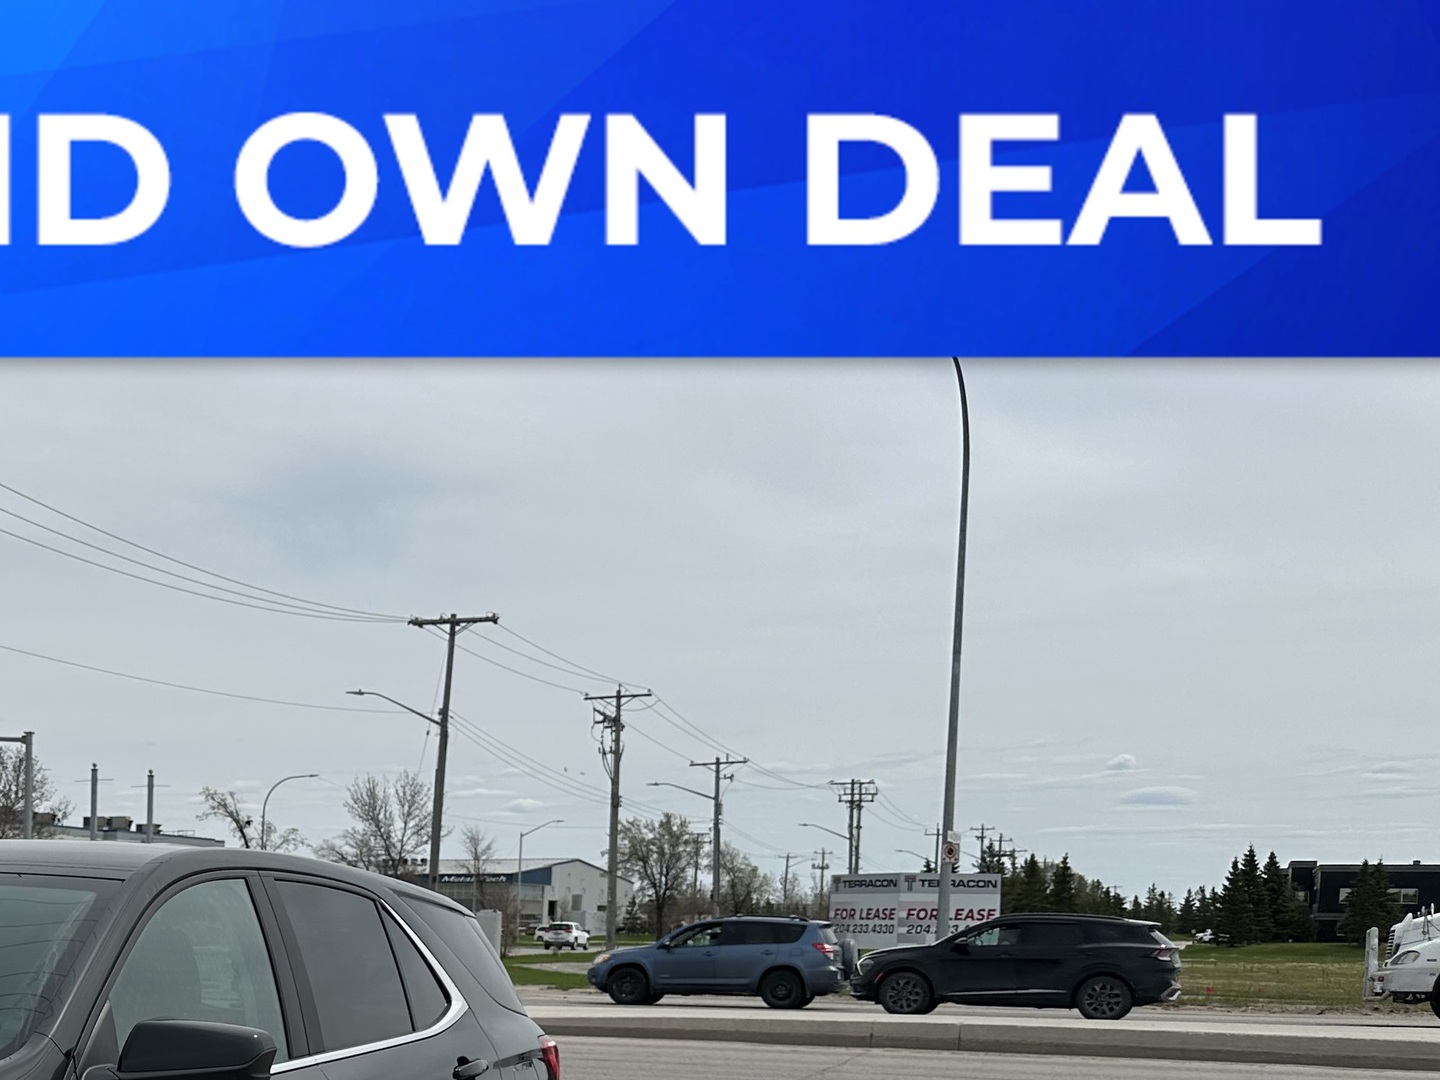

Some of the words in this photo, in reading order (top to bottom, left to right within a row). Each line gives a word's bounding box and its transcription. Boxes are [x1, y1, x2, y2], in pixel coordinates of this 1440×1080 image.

[842, 879, 898, 888] TERRACON
[919, 879, 998, 888] TERACON
[833, 908, 856, 920] FOR
[859, 908, 896, 920] LEASE
[906, 908, 938, 920] FOR
[948, 908, 997, 921] EASE
[834, 924, 895, 934] 204.233.4330
